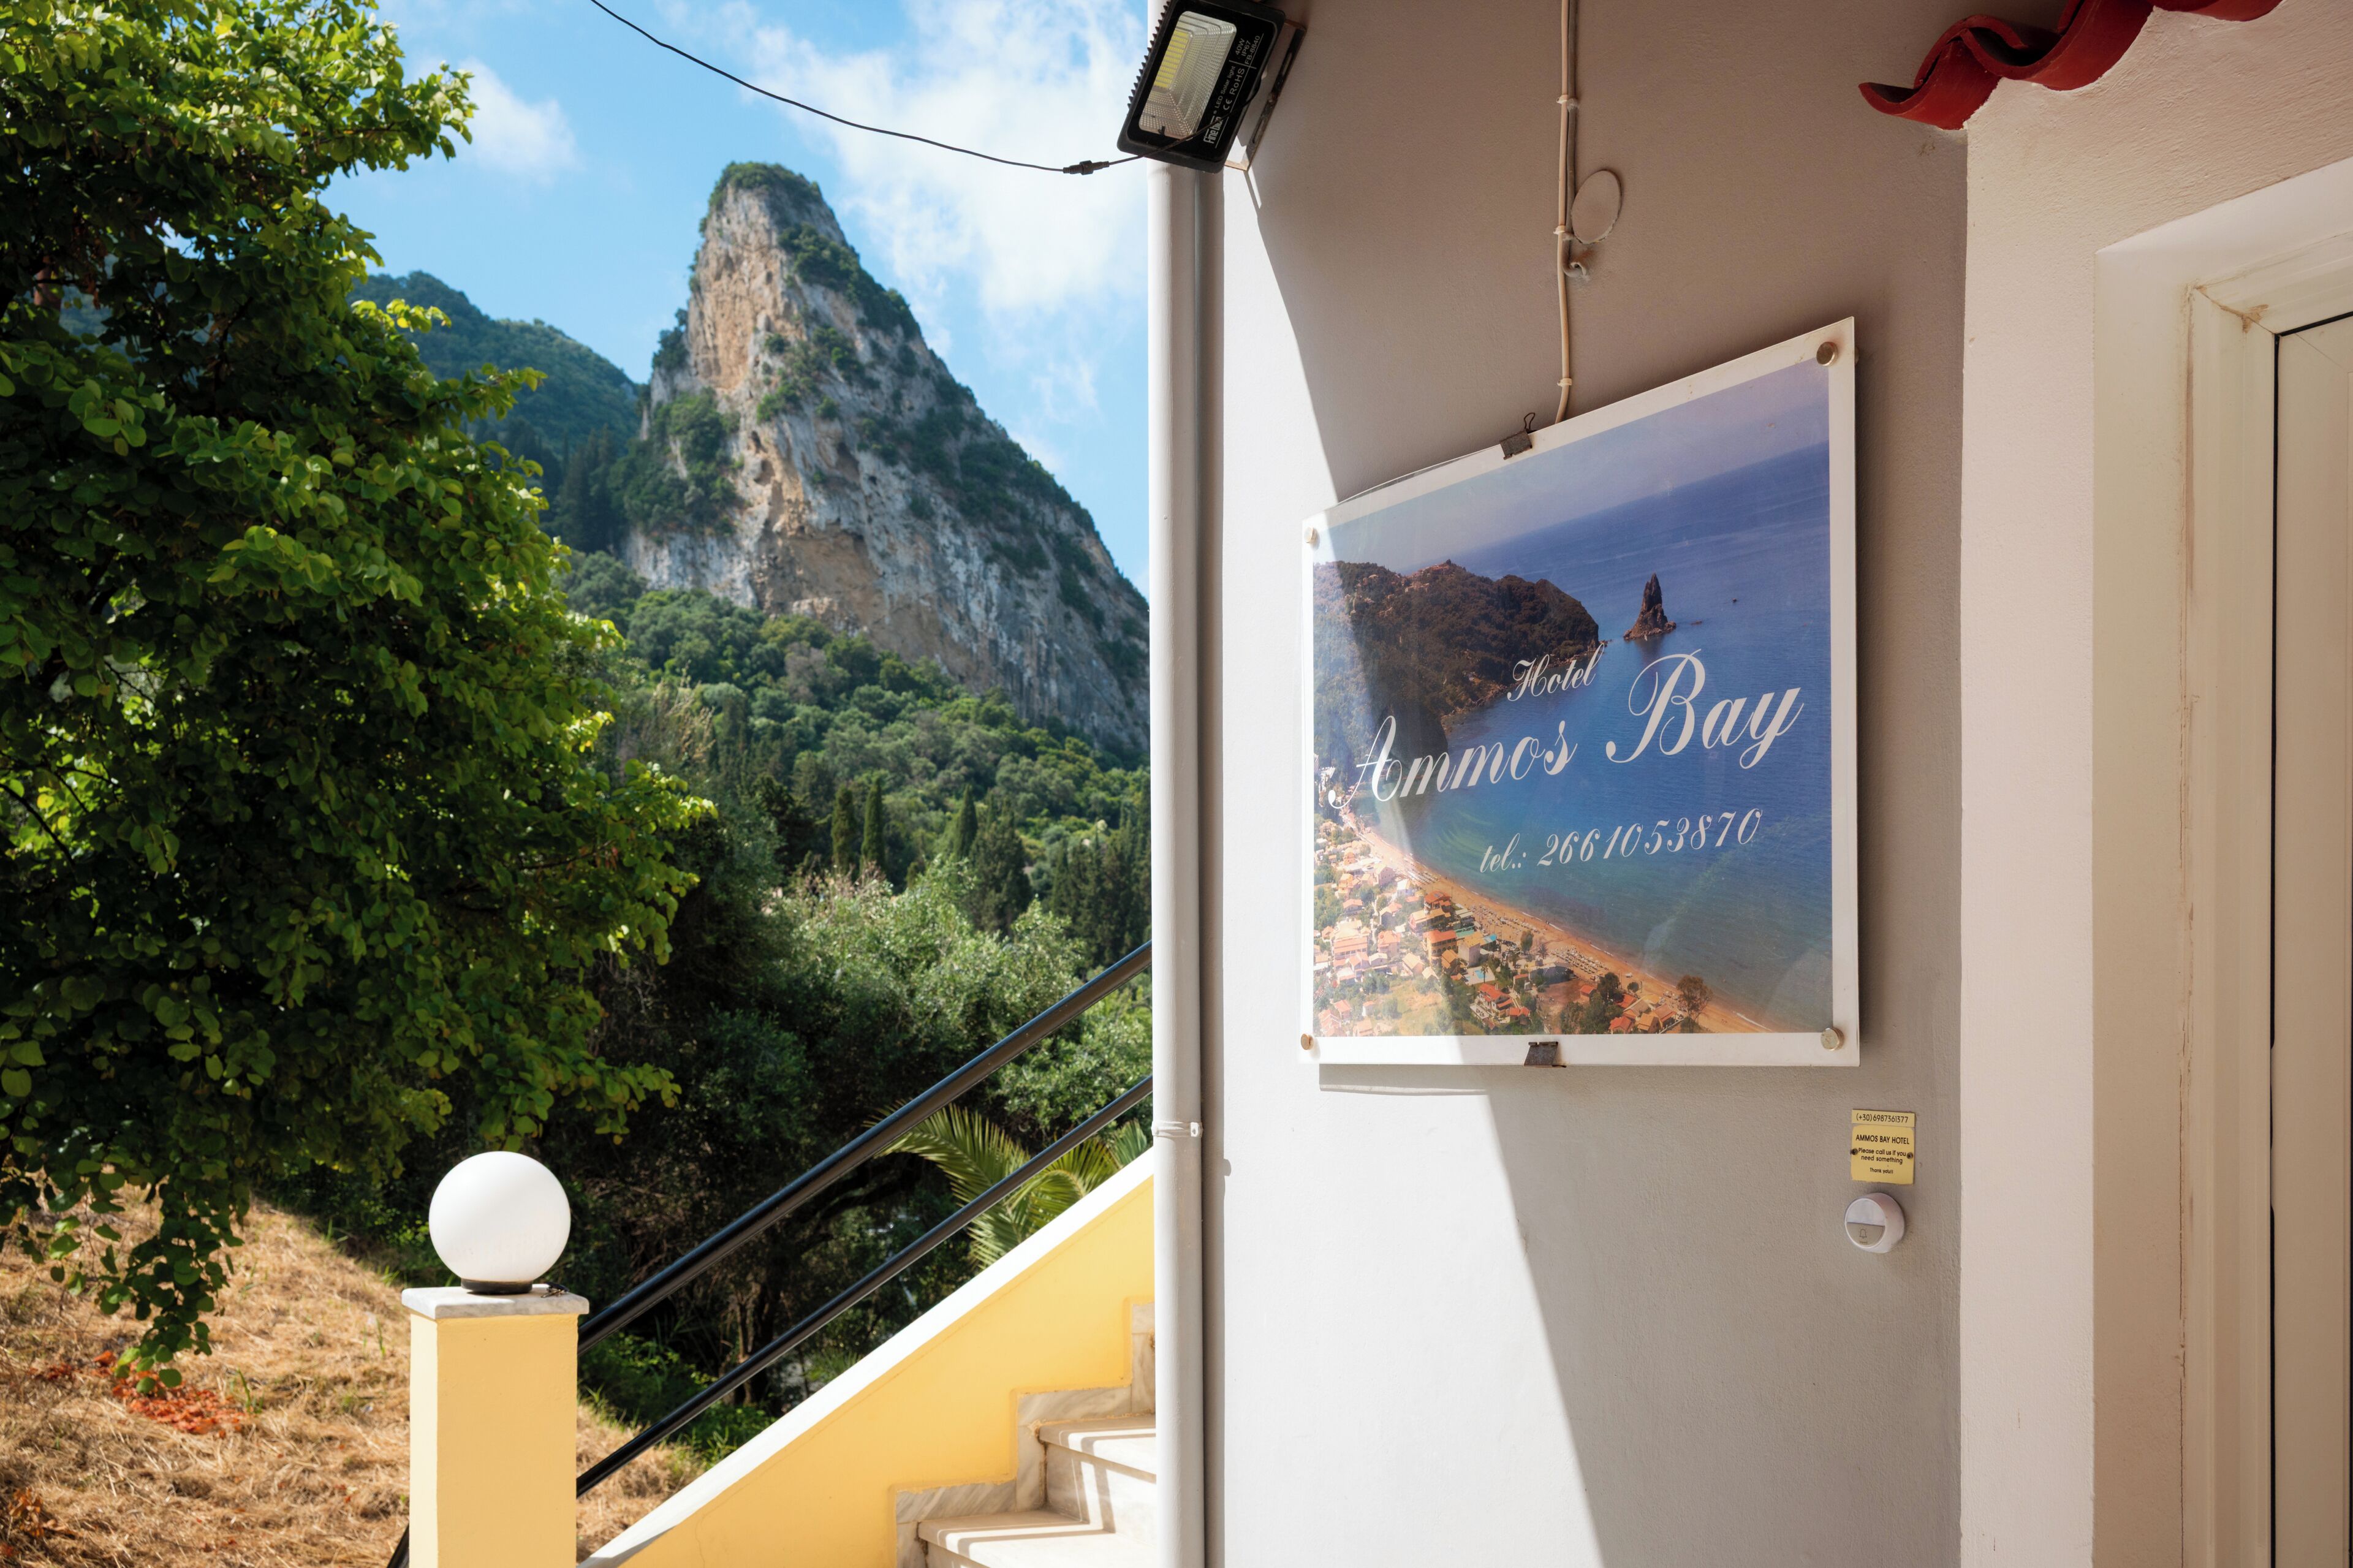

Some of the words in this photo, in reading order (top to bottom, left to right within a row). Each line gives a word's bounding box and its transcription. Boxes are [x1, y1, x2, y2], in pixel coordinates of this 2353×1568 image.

[1235, 38, 1245, 55] 40W
[1241, 40, 1251, 56] IP67
[1245, 36, 1260, 64] FB-8840
[1214, 96, 1223, 108] LED
[1221, 80, 1230, 94] Solar
[1227, 66, 1236, 78] light
[1223, 99, 1232, 110] CE
[1229, 68, 1245, 95] RoHS
[1507, 643, 1605, 702] Hotel
[1328, 715, 1578, 809] Ammos
[1605, 648, 1805, 769] Bay
[1480, 832, 1527, 873] tel.:
[1536, 808, 1763, 867] 2661053870
